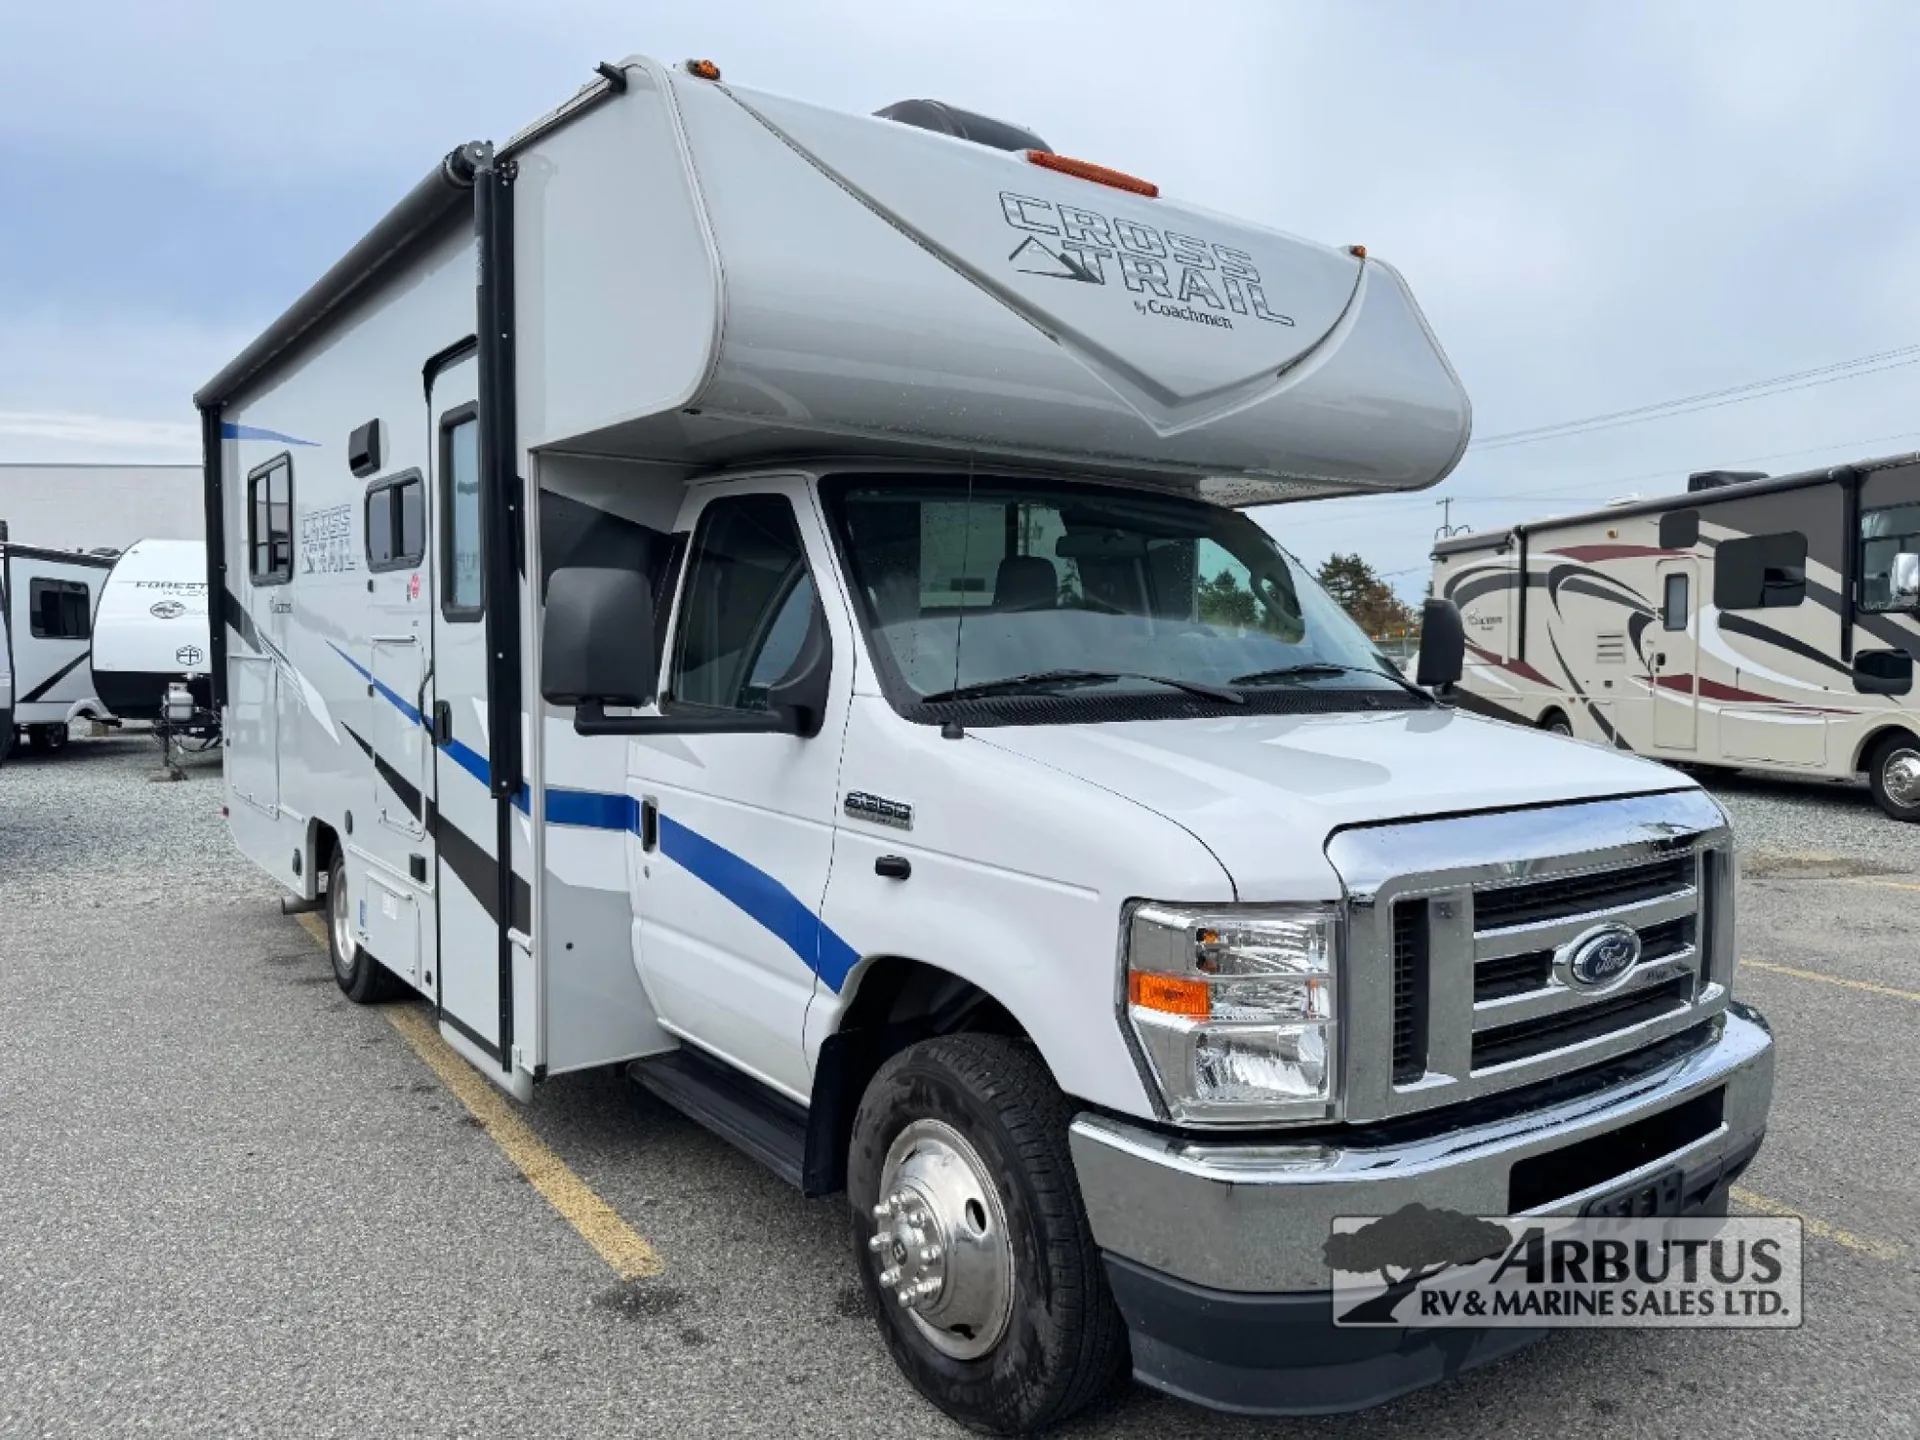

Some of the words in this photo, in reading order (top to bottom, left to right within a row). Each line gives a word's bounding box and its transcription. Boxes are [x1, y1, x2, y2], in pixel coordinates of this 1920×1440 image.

[998, 190, 1262, 284] CROSS
[1061, 239, 1296, 327] TRAIL
[1147, 299, 1234, 331] Coachmen
